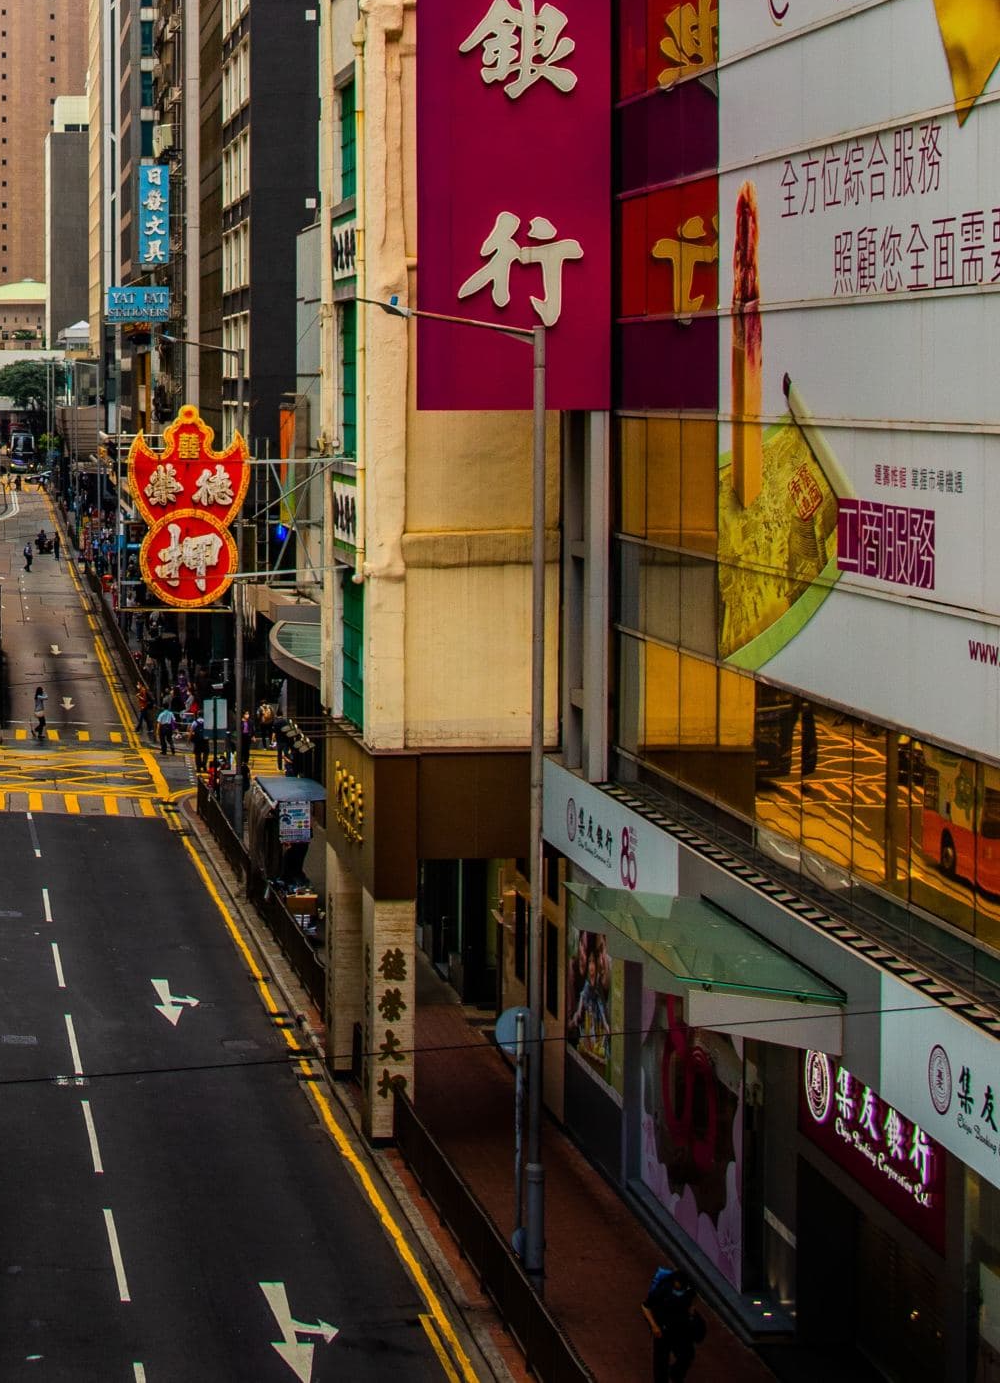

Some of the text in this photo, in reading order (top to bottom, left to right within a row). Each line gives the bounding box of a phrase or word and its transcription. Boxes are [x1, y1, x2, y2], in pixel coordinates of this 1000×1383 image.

[781, 118, 942, 218] 全方位綜合服務
[143, 168, 168, 263] 日發文具
[109, 307, 169, 318] STATIONERS
[112, 292, 169, 305] YAT FAT
[155, 523, 224, 592] 押
[838, 507, 935, 588] 工商服務
[578, 807, 612, 856] 集友銀行
[620, 827, 637, 890] 80
[835, 1066, 931, 1185] 集友銀行
